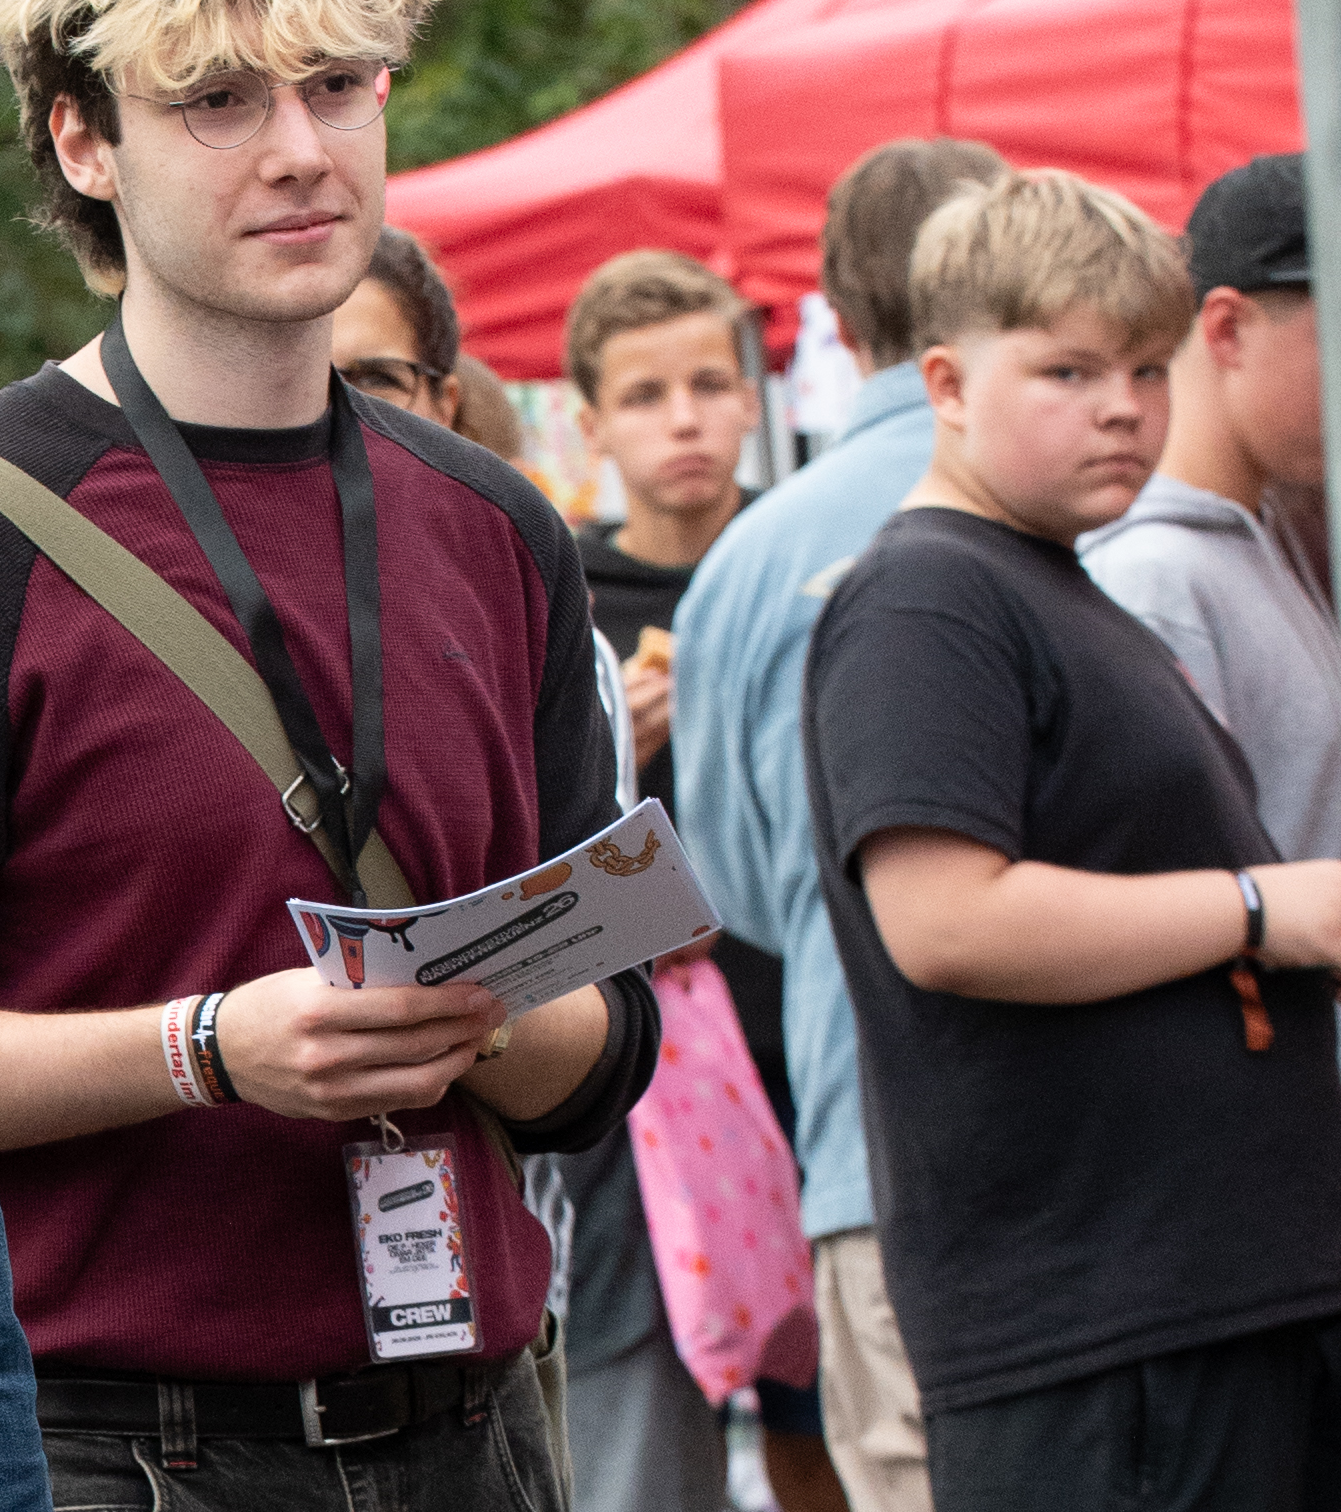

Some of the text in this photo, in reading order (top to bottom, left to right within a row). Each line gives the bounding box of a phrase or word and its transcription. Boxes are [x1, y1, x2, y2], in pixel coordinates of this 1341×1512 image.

[542, 894, 576, 919] 26
[167, 997, 187, 1079] kindertag
[378, 1228, 443, 1244] EKO FRESH
[390, 1303, 452, 1327] CREW
